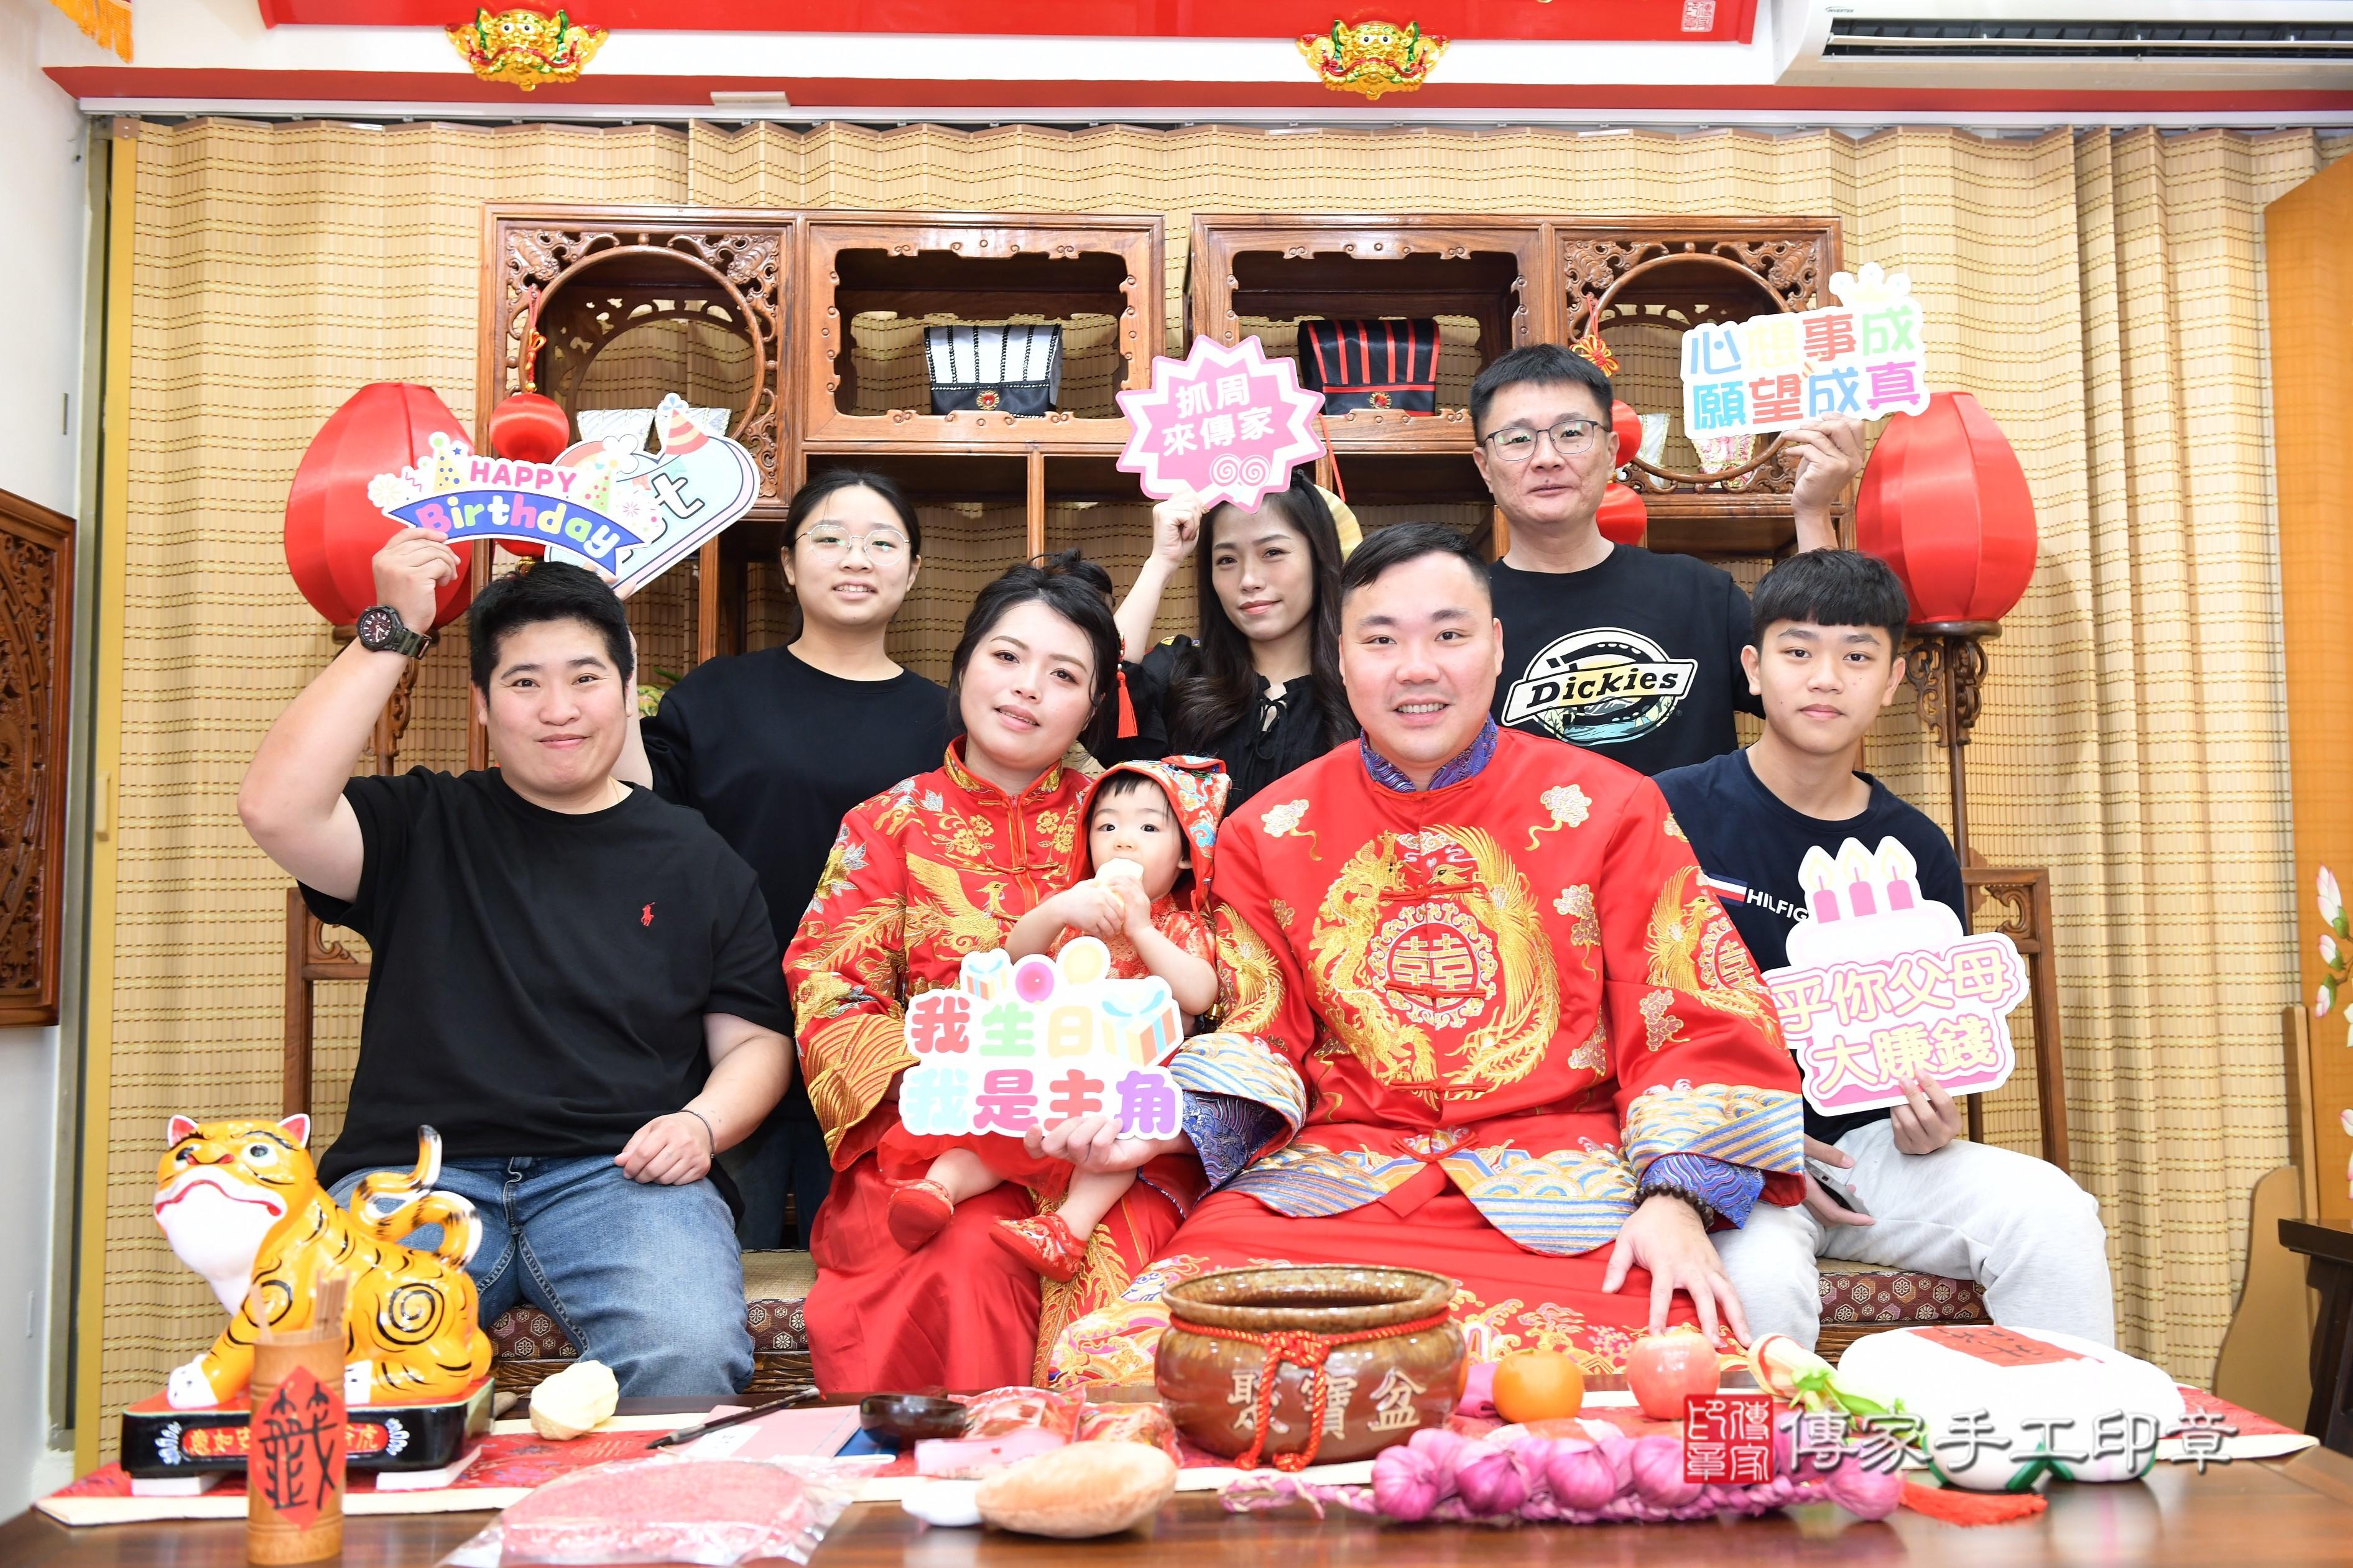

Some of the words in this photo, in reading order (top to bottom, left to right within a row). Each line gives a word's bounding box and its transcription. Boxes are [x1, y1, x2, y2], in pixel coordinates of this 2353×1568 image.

[1690, 304, 1916, 375] 心想事成
[1175, 372, 1250, 419] 抓周
[1693, 361, 1921, 430] 願望成真
[1162, 406, 1275, 457] 來傳家
[470, 460, 577, 494] HAPPY
[415, 493, 622, 559] Birthday
[1526, 667, 1679, 709] Dickies
[1770, 947, 2012, 1036] 乎你父母
[910, 995, 1093, 1059] 我生日
[1811, 1013, 1999, 1095] 大賺錢
[904, 1067, 1176, 1134] 我是主角
[1226, 1366, 1428, 1441] 聚寶盆
